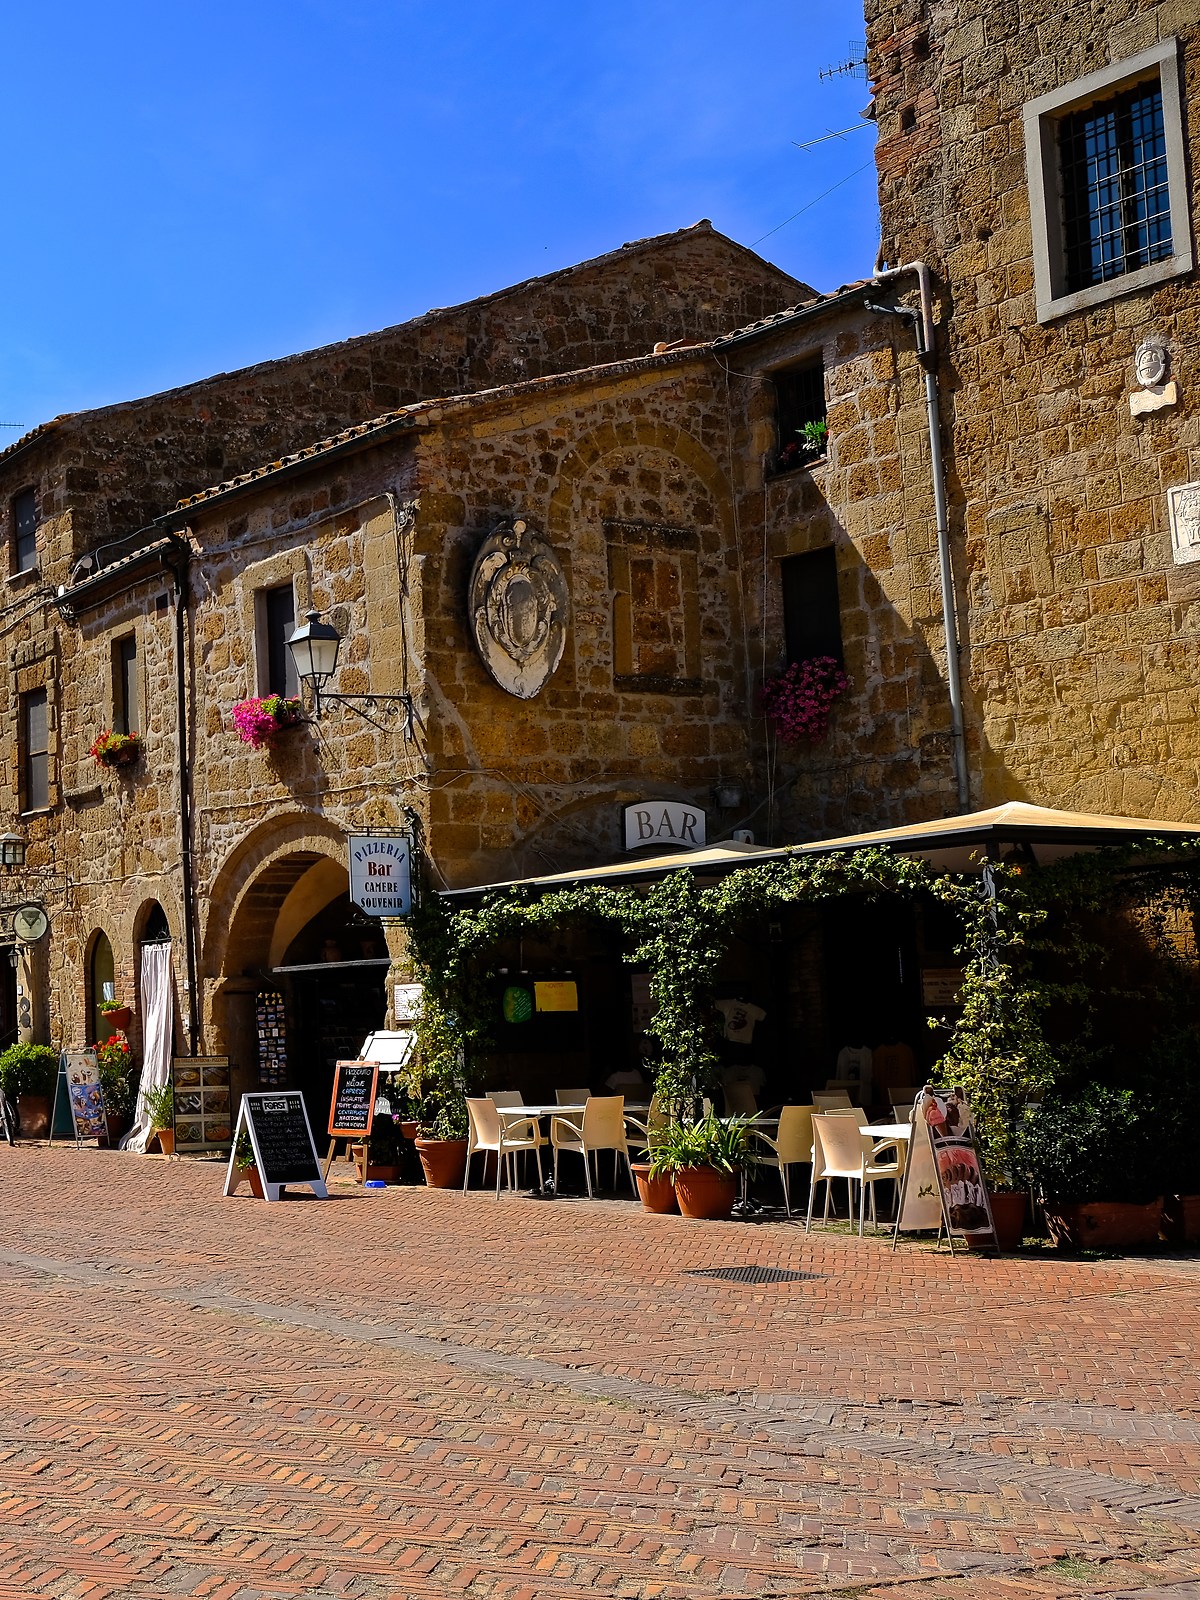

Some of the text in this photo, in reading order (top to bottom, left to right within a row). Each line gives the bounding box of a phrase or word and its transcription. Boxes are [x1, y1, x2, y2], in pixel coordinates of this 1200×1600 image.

[634, 809, 700, 843] BAR
[354, 842, 406, 863] PIZZERIA
[367, 861, 393, 876] Bar
[364, 881, 399, 893] CAMERE
[360, 897, 403, 908] SOUVENIR
